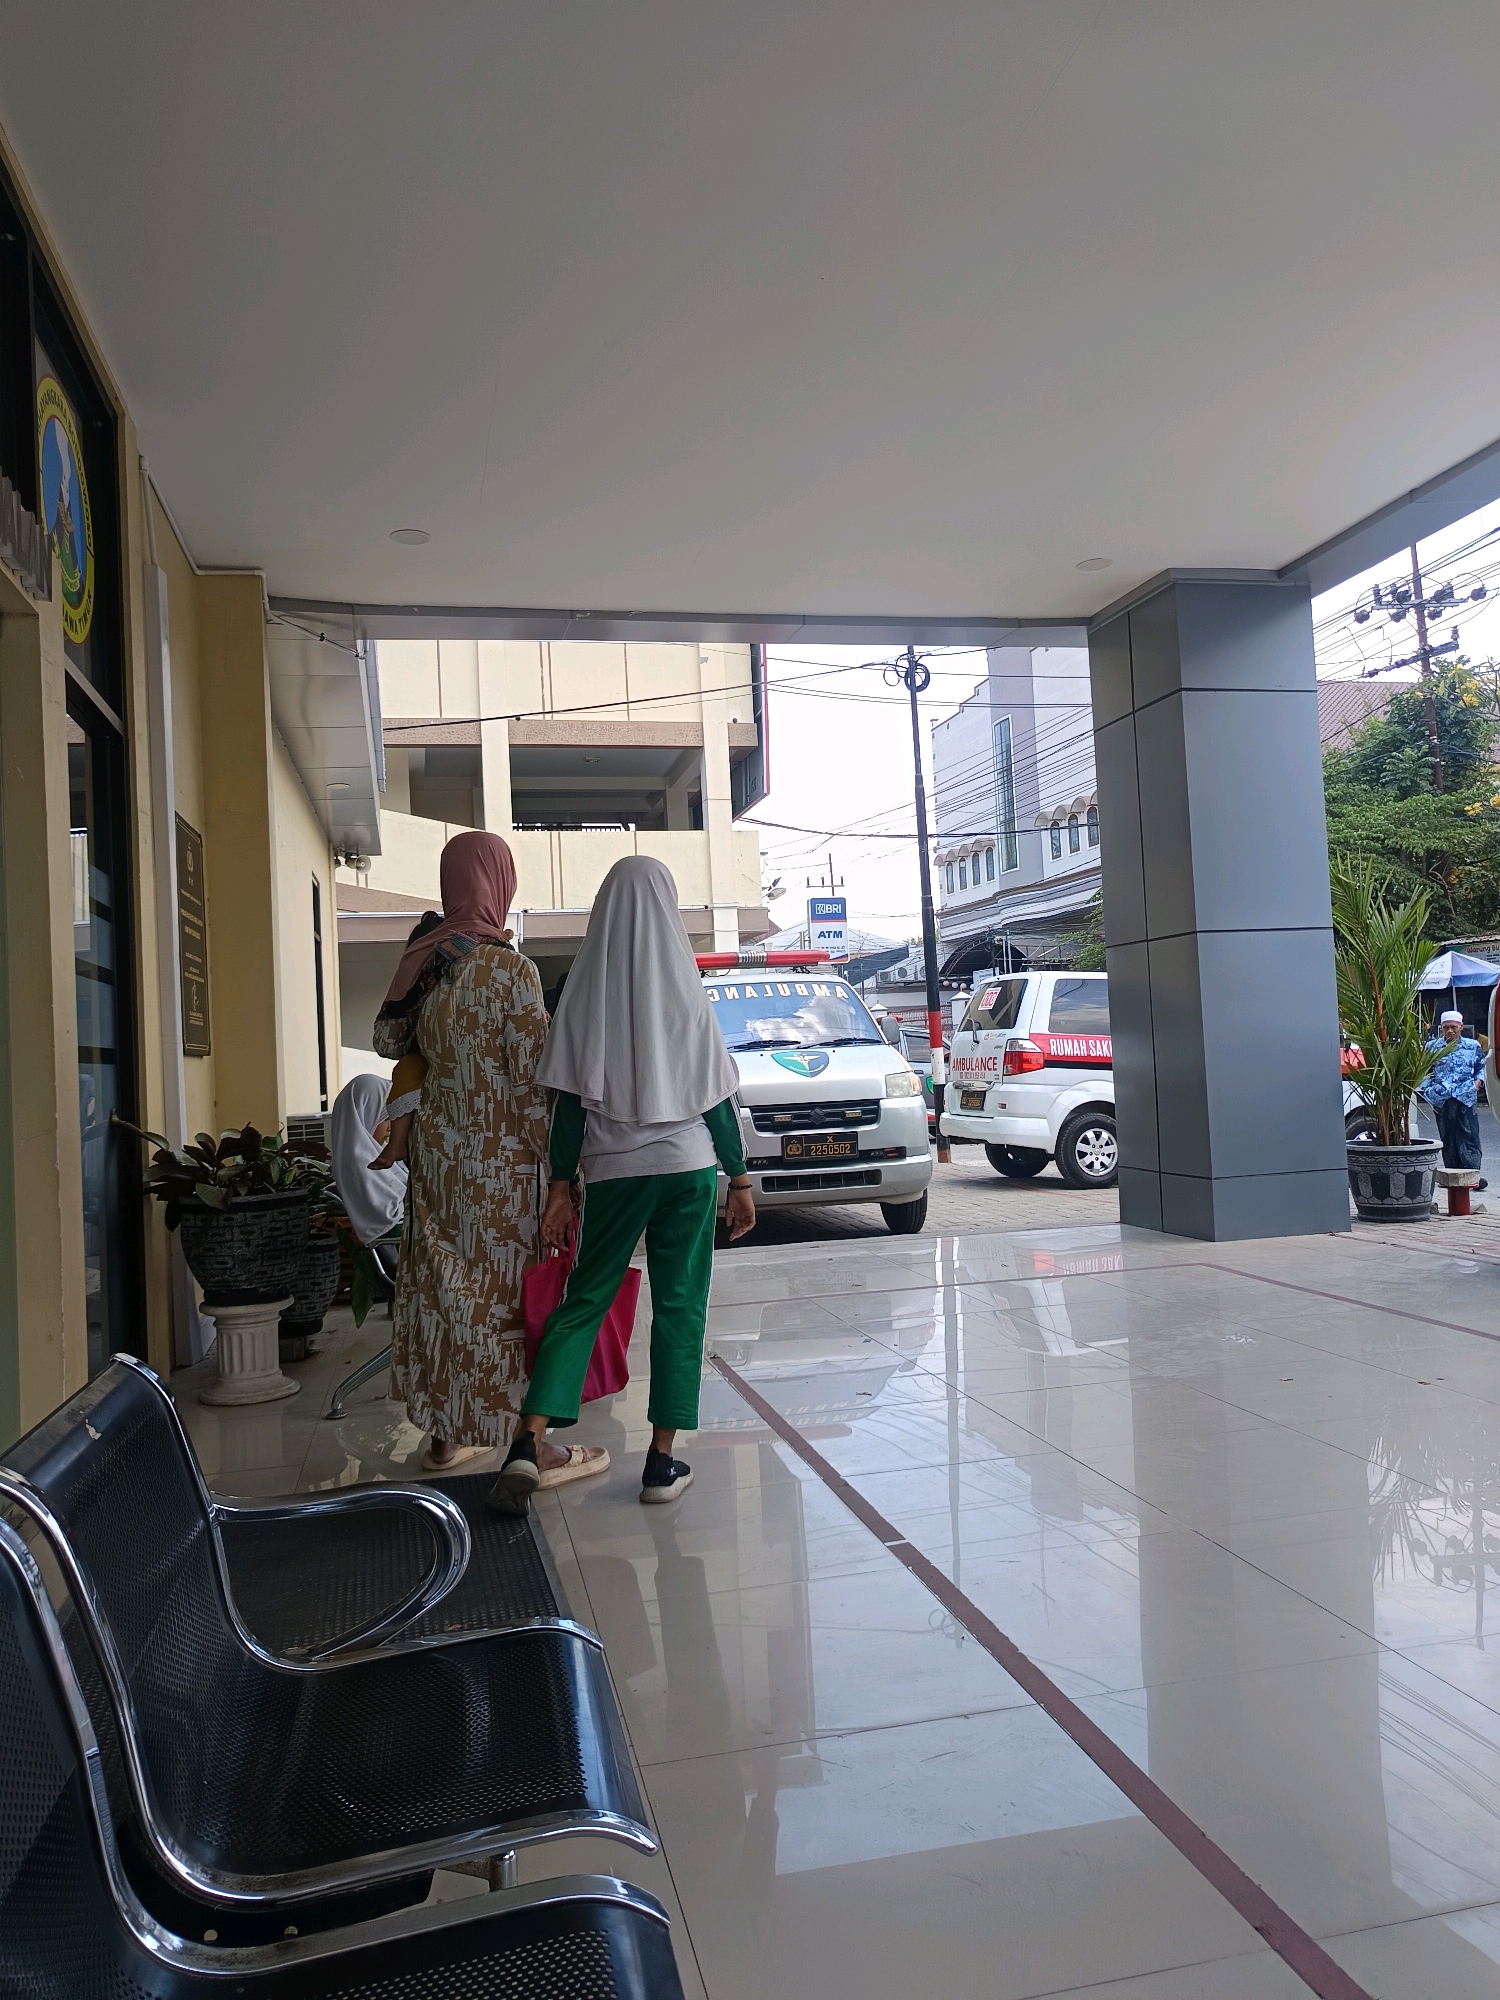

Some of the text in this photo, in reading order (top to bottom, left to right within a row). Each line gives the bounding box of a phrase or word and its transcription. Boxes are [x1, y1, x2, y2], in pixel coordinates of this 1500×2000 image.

[826, 904, 842, 914] BRI
[817, 930, 843, 939] ATM
[1049, 1038, 1088, 1057] RUMAH
[951, 1056, 998, 1072] AMBULANCE
[826, 1135, 834, 1143] X
